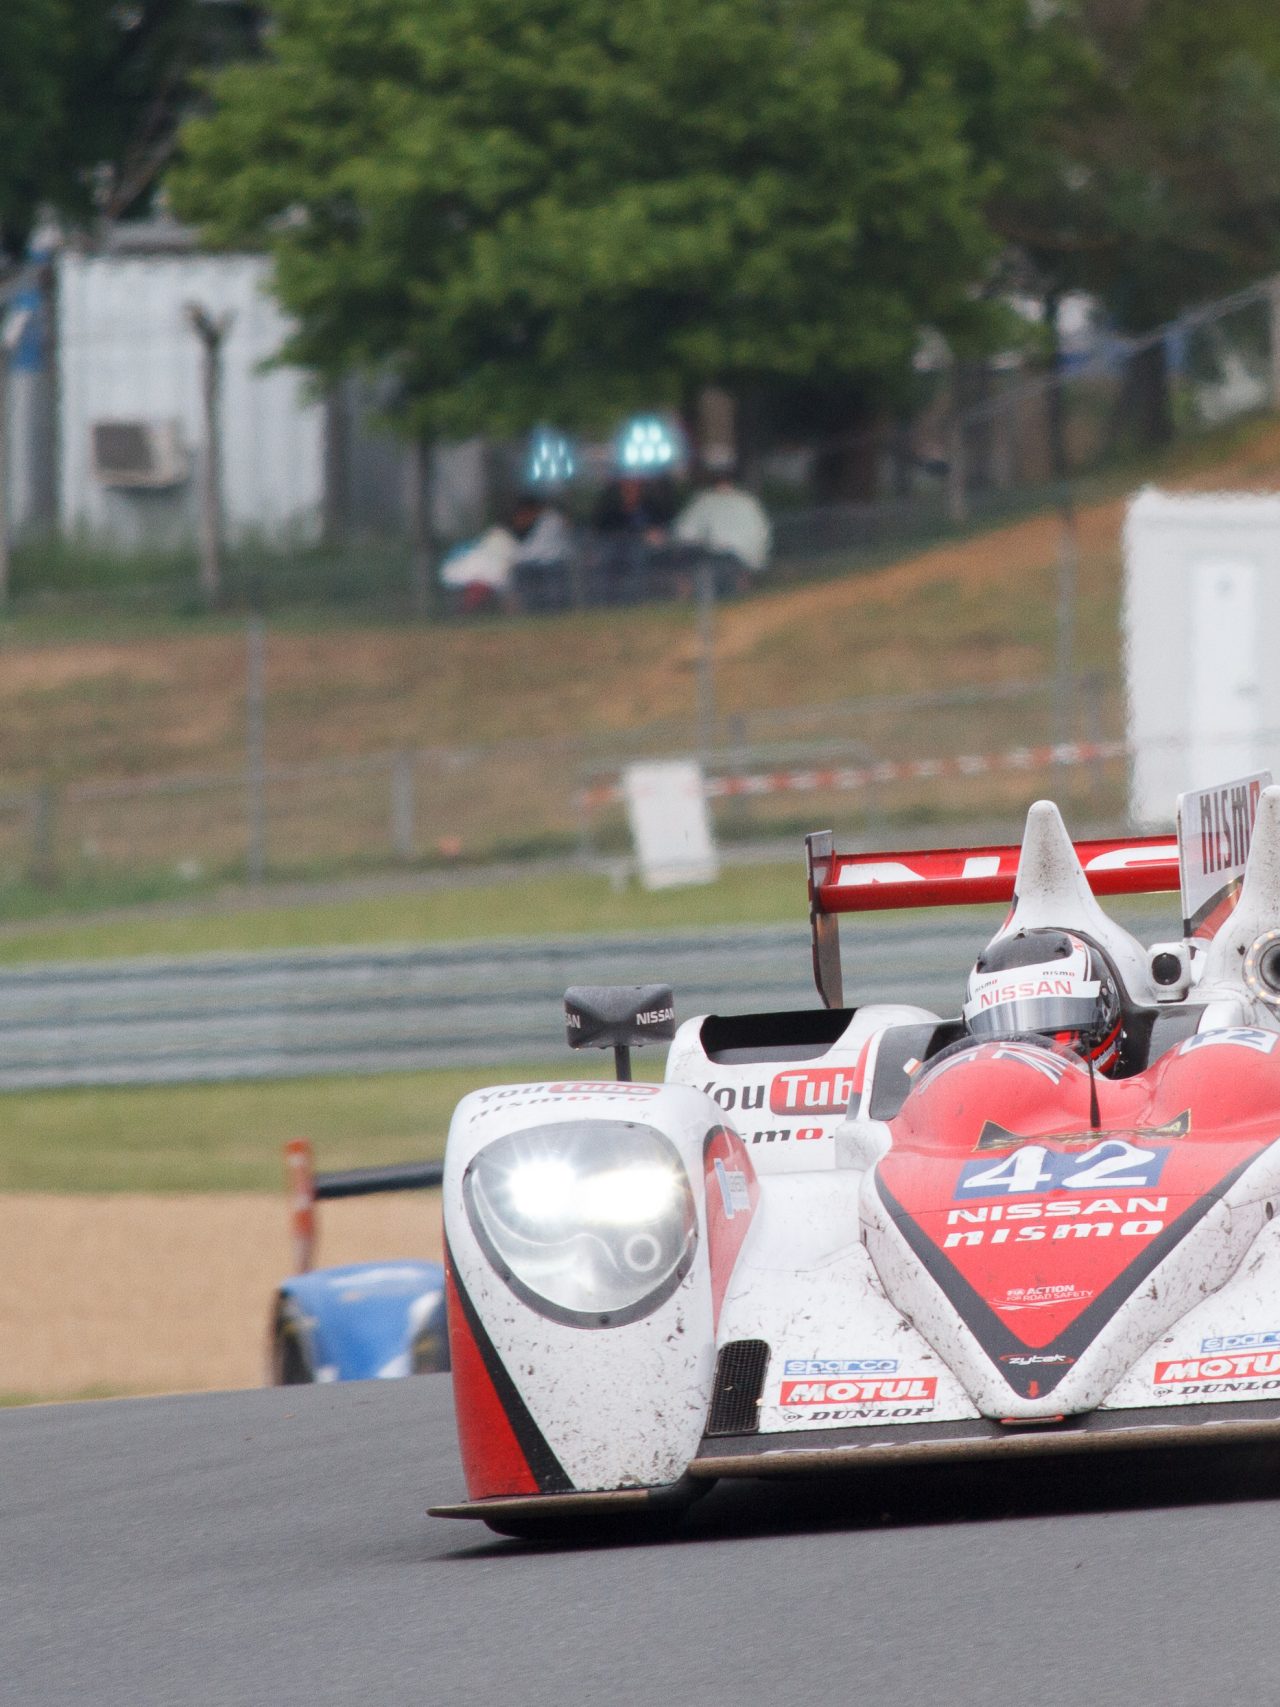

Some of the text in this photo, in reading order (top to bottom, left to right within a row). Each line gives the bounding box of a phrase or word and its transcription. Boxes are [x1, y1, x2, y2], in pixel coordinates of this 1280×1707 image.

[978, 980, 1074, 1009] NISSAN
[1189, 1028, 1267, 1047] P2
[962, 1140, 1156, 1192] 42
[946, 1197, 1168, 1225] NISSAN
[942, 1220, 1165, 1248] nismo
[1023, 1293, 1052, 1302] ROAD
[1053, 1289, 1094, 1299] SAFETY
[1026, 1284, 1076, 1296] ACTION
[785, 1359, 898, 1374] sparco
[786, 1380, 930, 1402] MOTUL
[807, 1407, 935, 1421] DUNLOP
